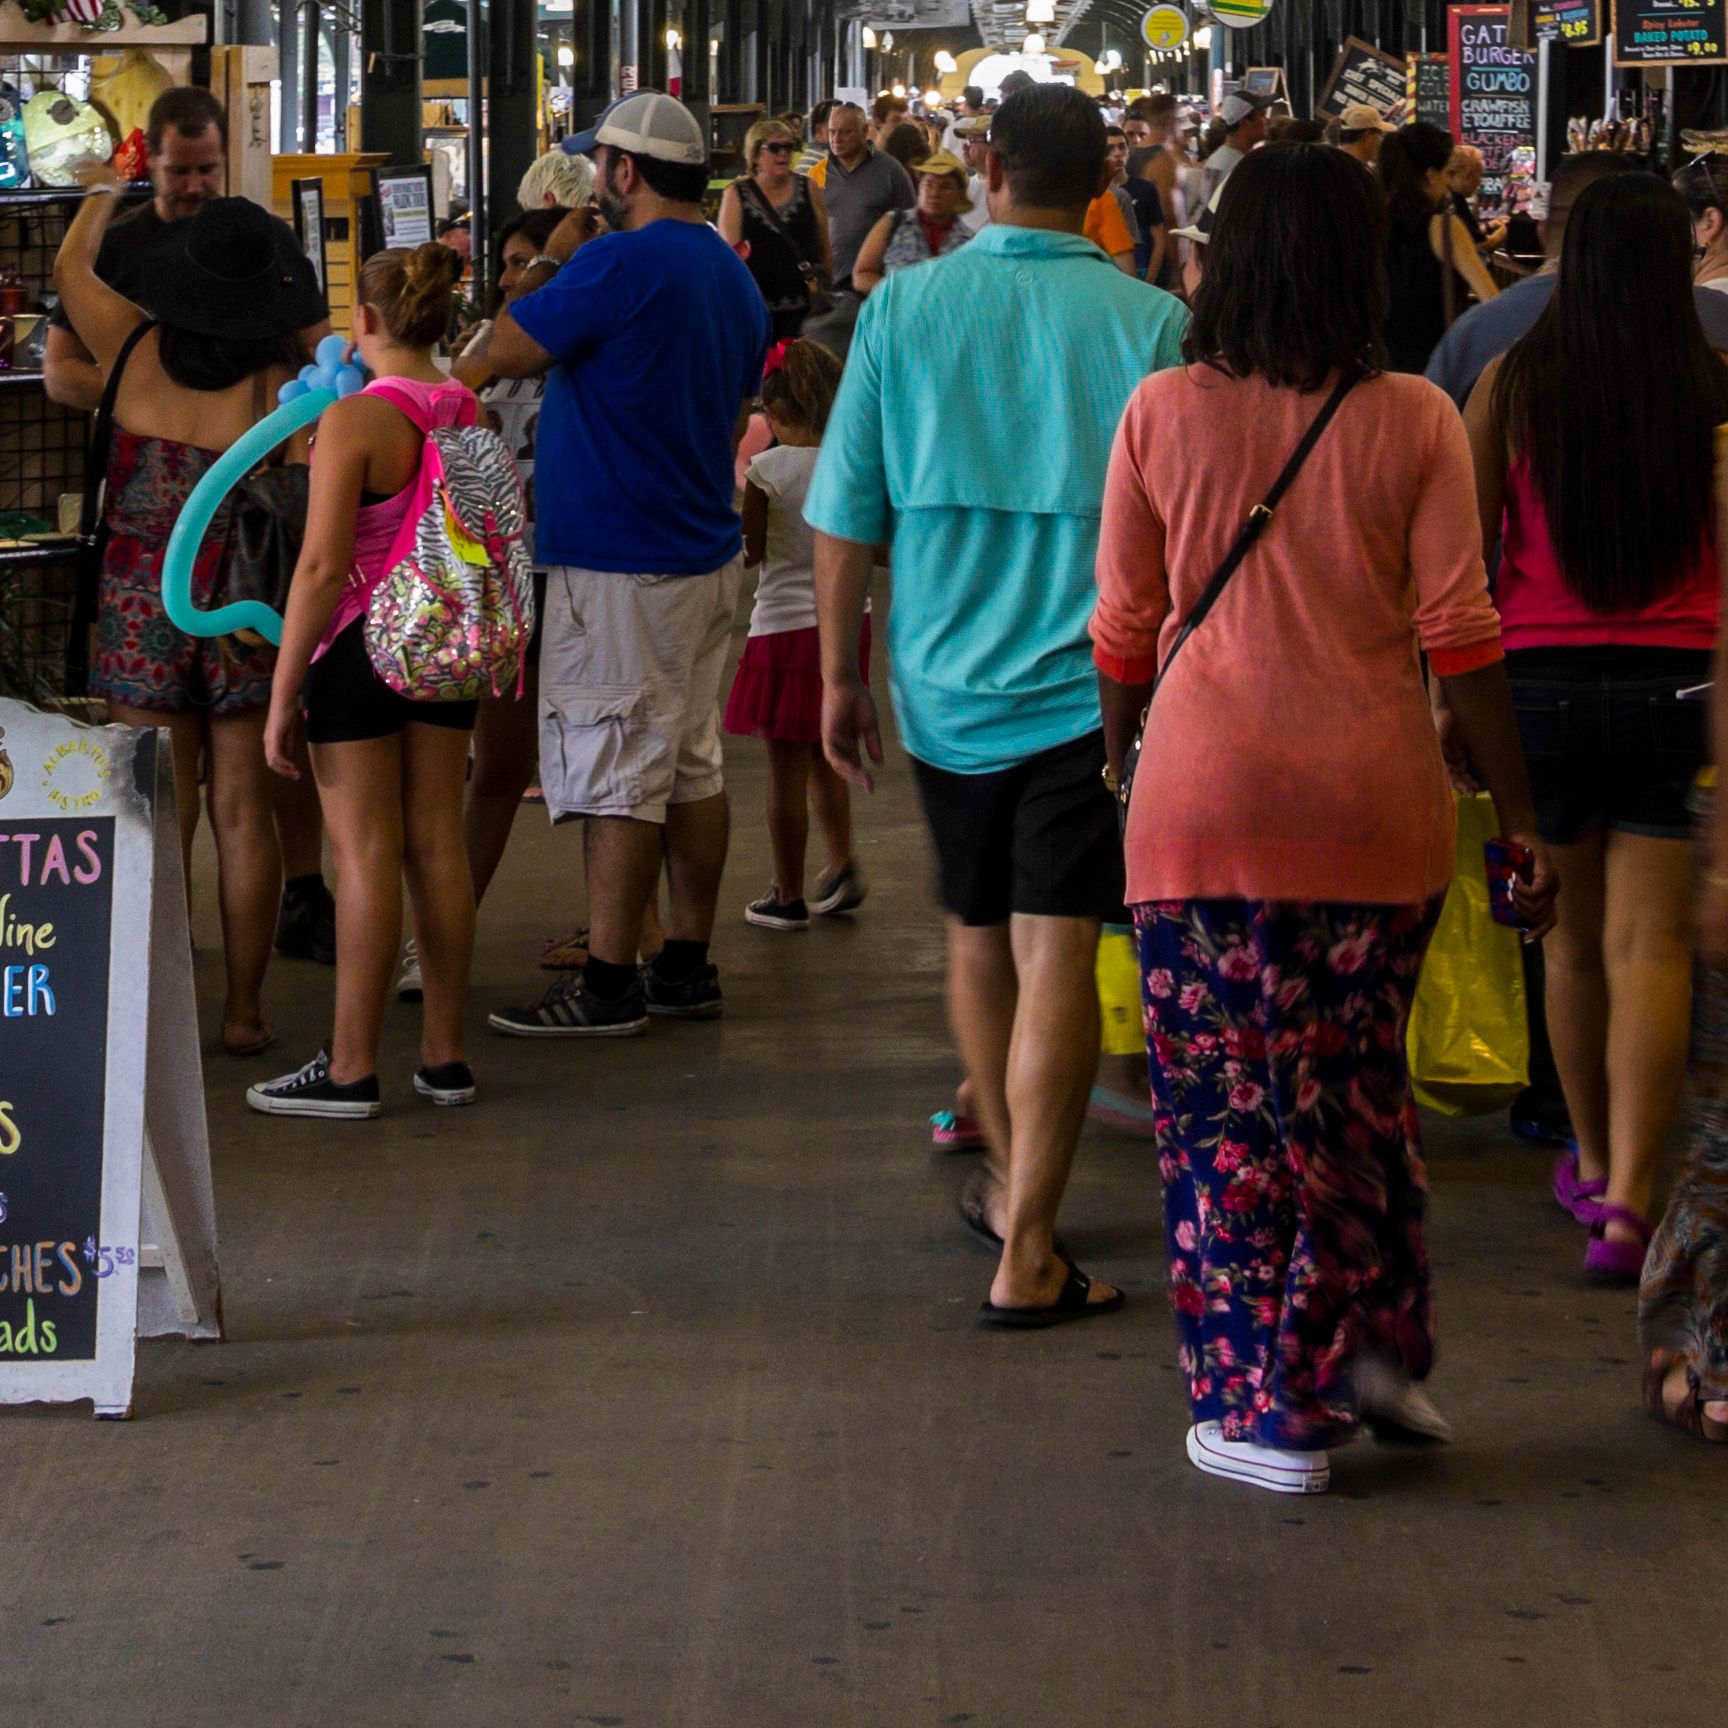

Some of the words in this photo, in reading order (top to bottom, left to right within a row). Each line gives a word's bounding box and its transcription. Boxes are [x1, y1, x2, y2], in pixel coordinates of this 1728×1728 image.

[1461, 24, 1507, 45] GAT
[1467, 73, 1531, 92] GUMBO
[1461, 99, 1530, 114] CRAWFISH
[1461, 113, 1532, 129] ETOUFFEE
